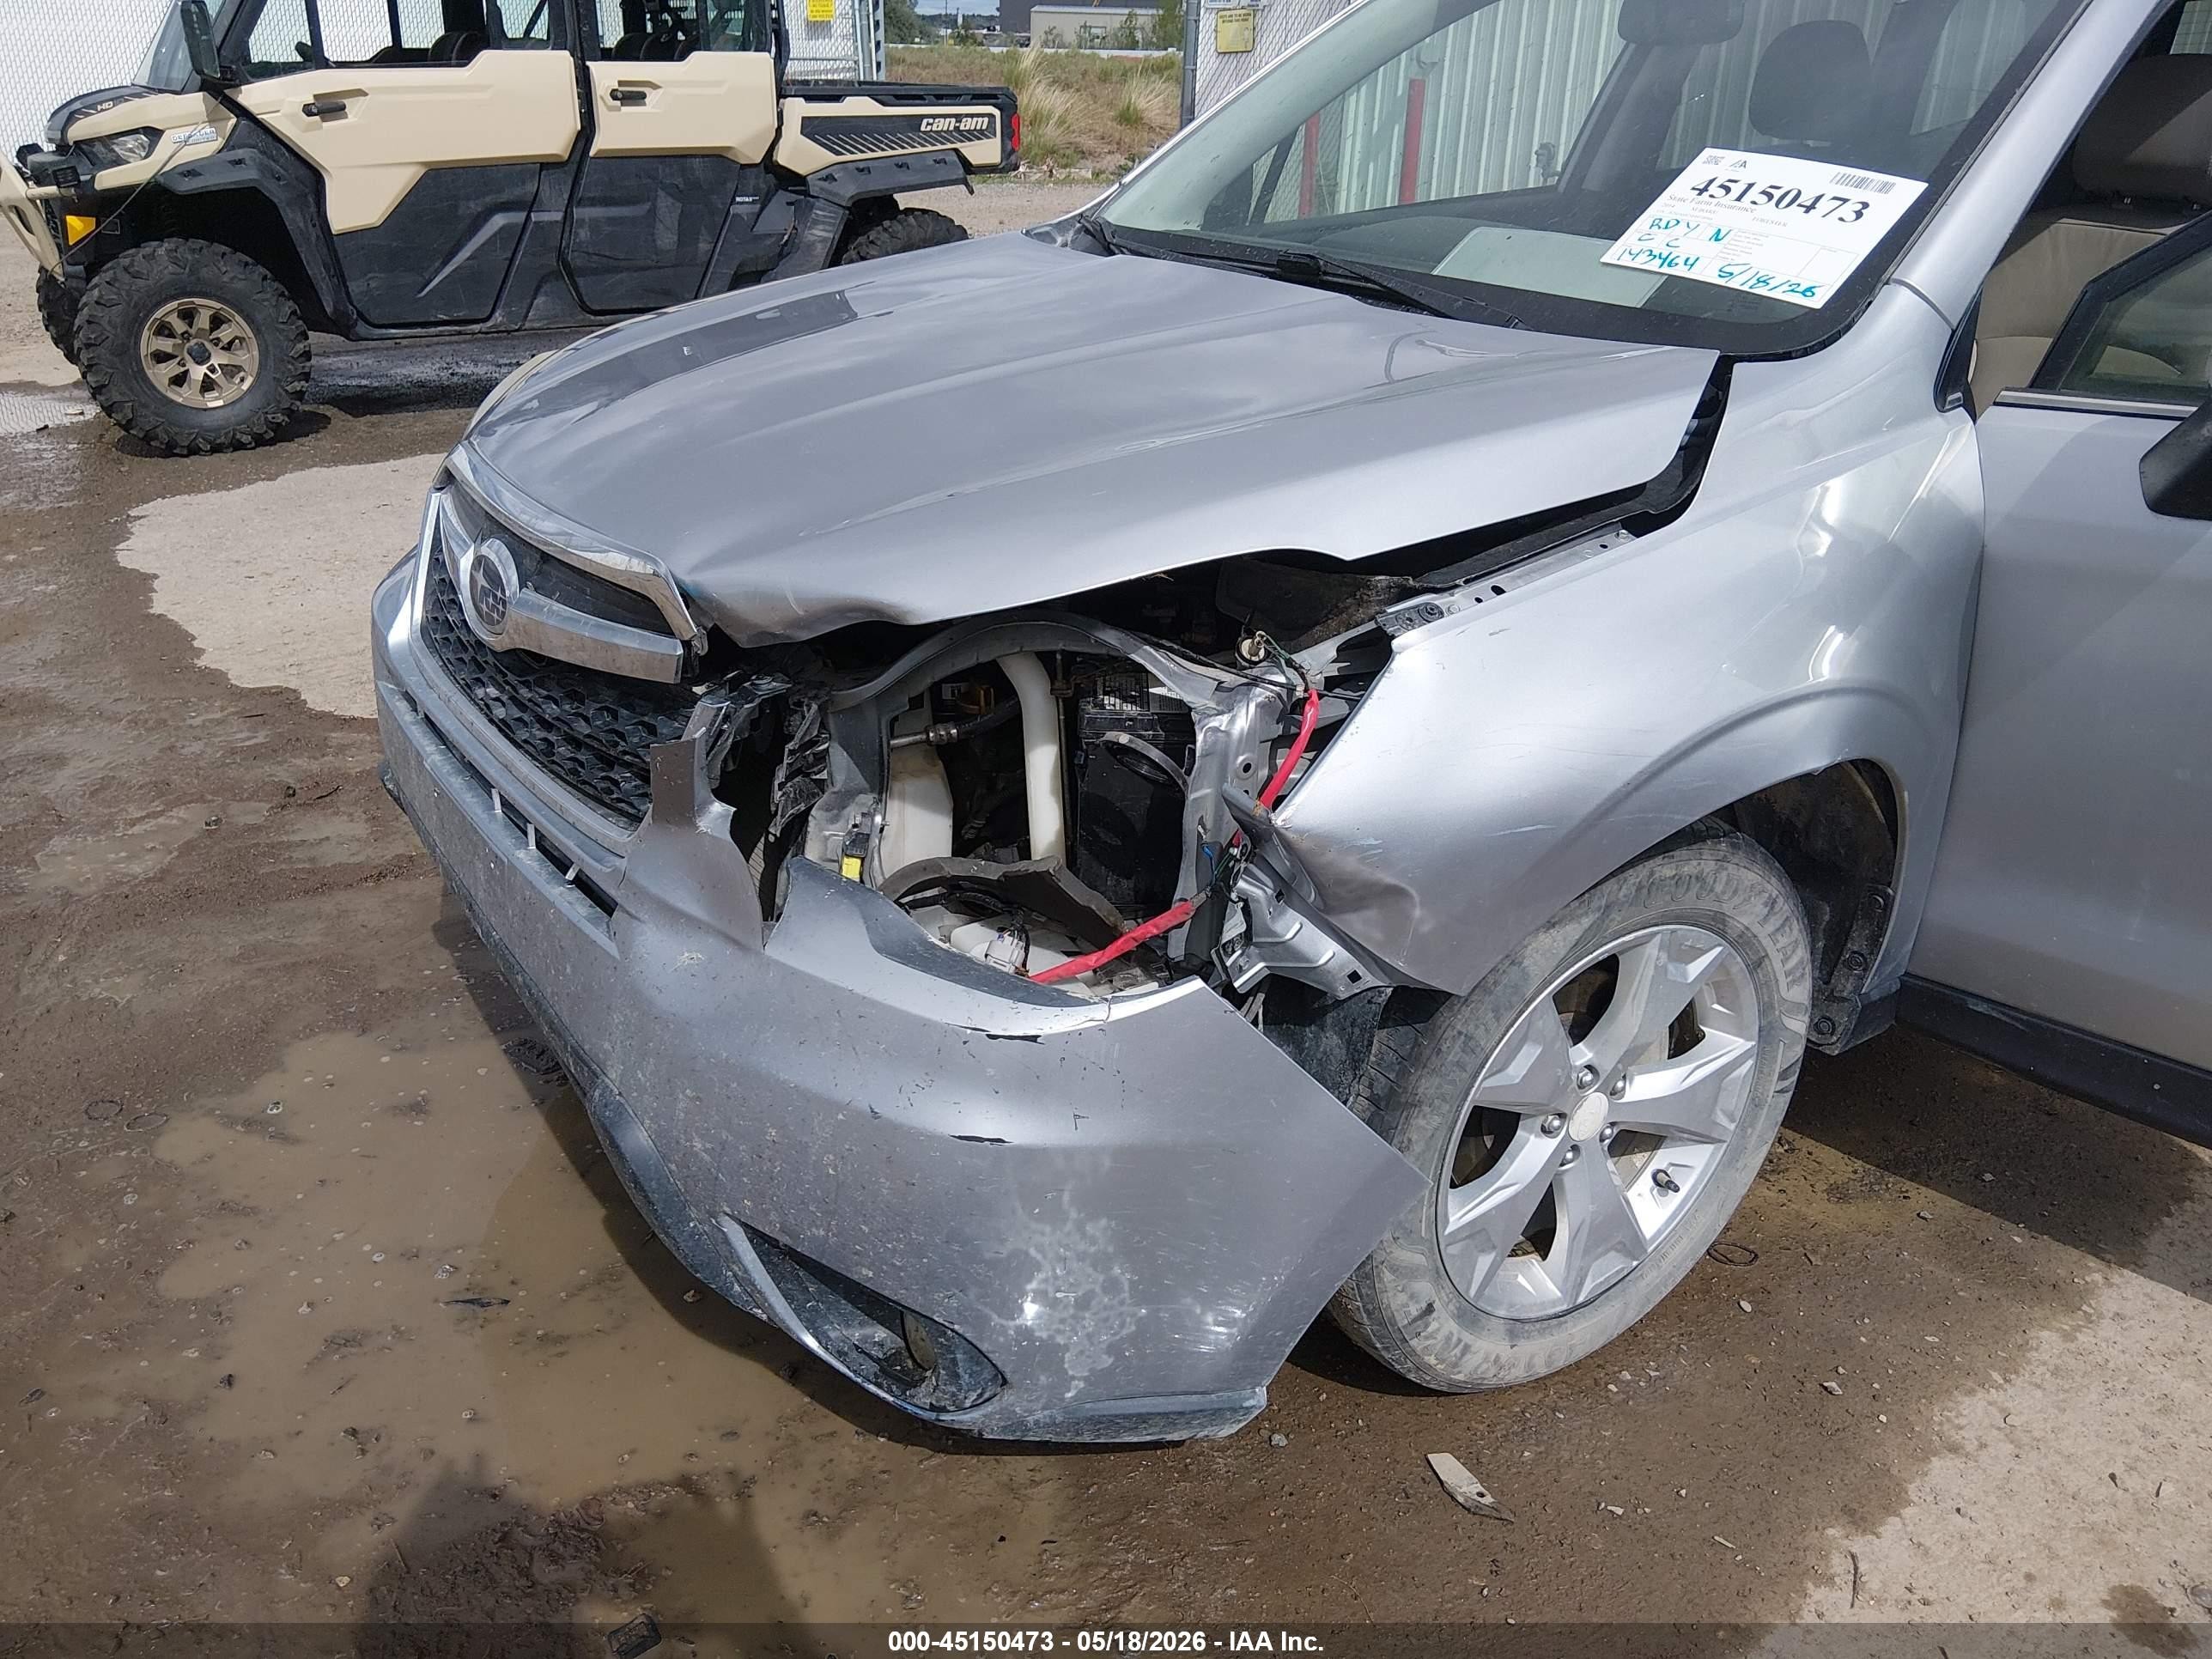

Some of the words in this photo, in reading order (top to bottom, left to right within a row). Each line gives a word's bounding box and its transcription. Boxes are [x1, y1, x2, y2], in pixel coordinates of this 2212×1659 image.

[920, 116, 989, 132] can-am
[172, 129, 216, 140] DEFDER
[1668, 192, 1688, 204] State
[1690, 196, 1713, 208] Farm
[1712, 199, 1758, 214] Insurance
[1691, 176, 1872, 223] 45150473
